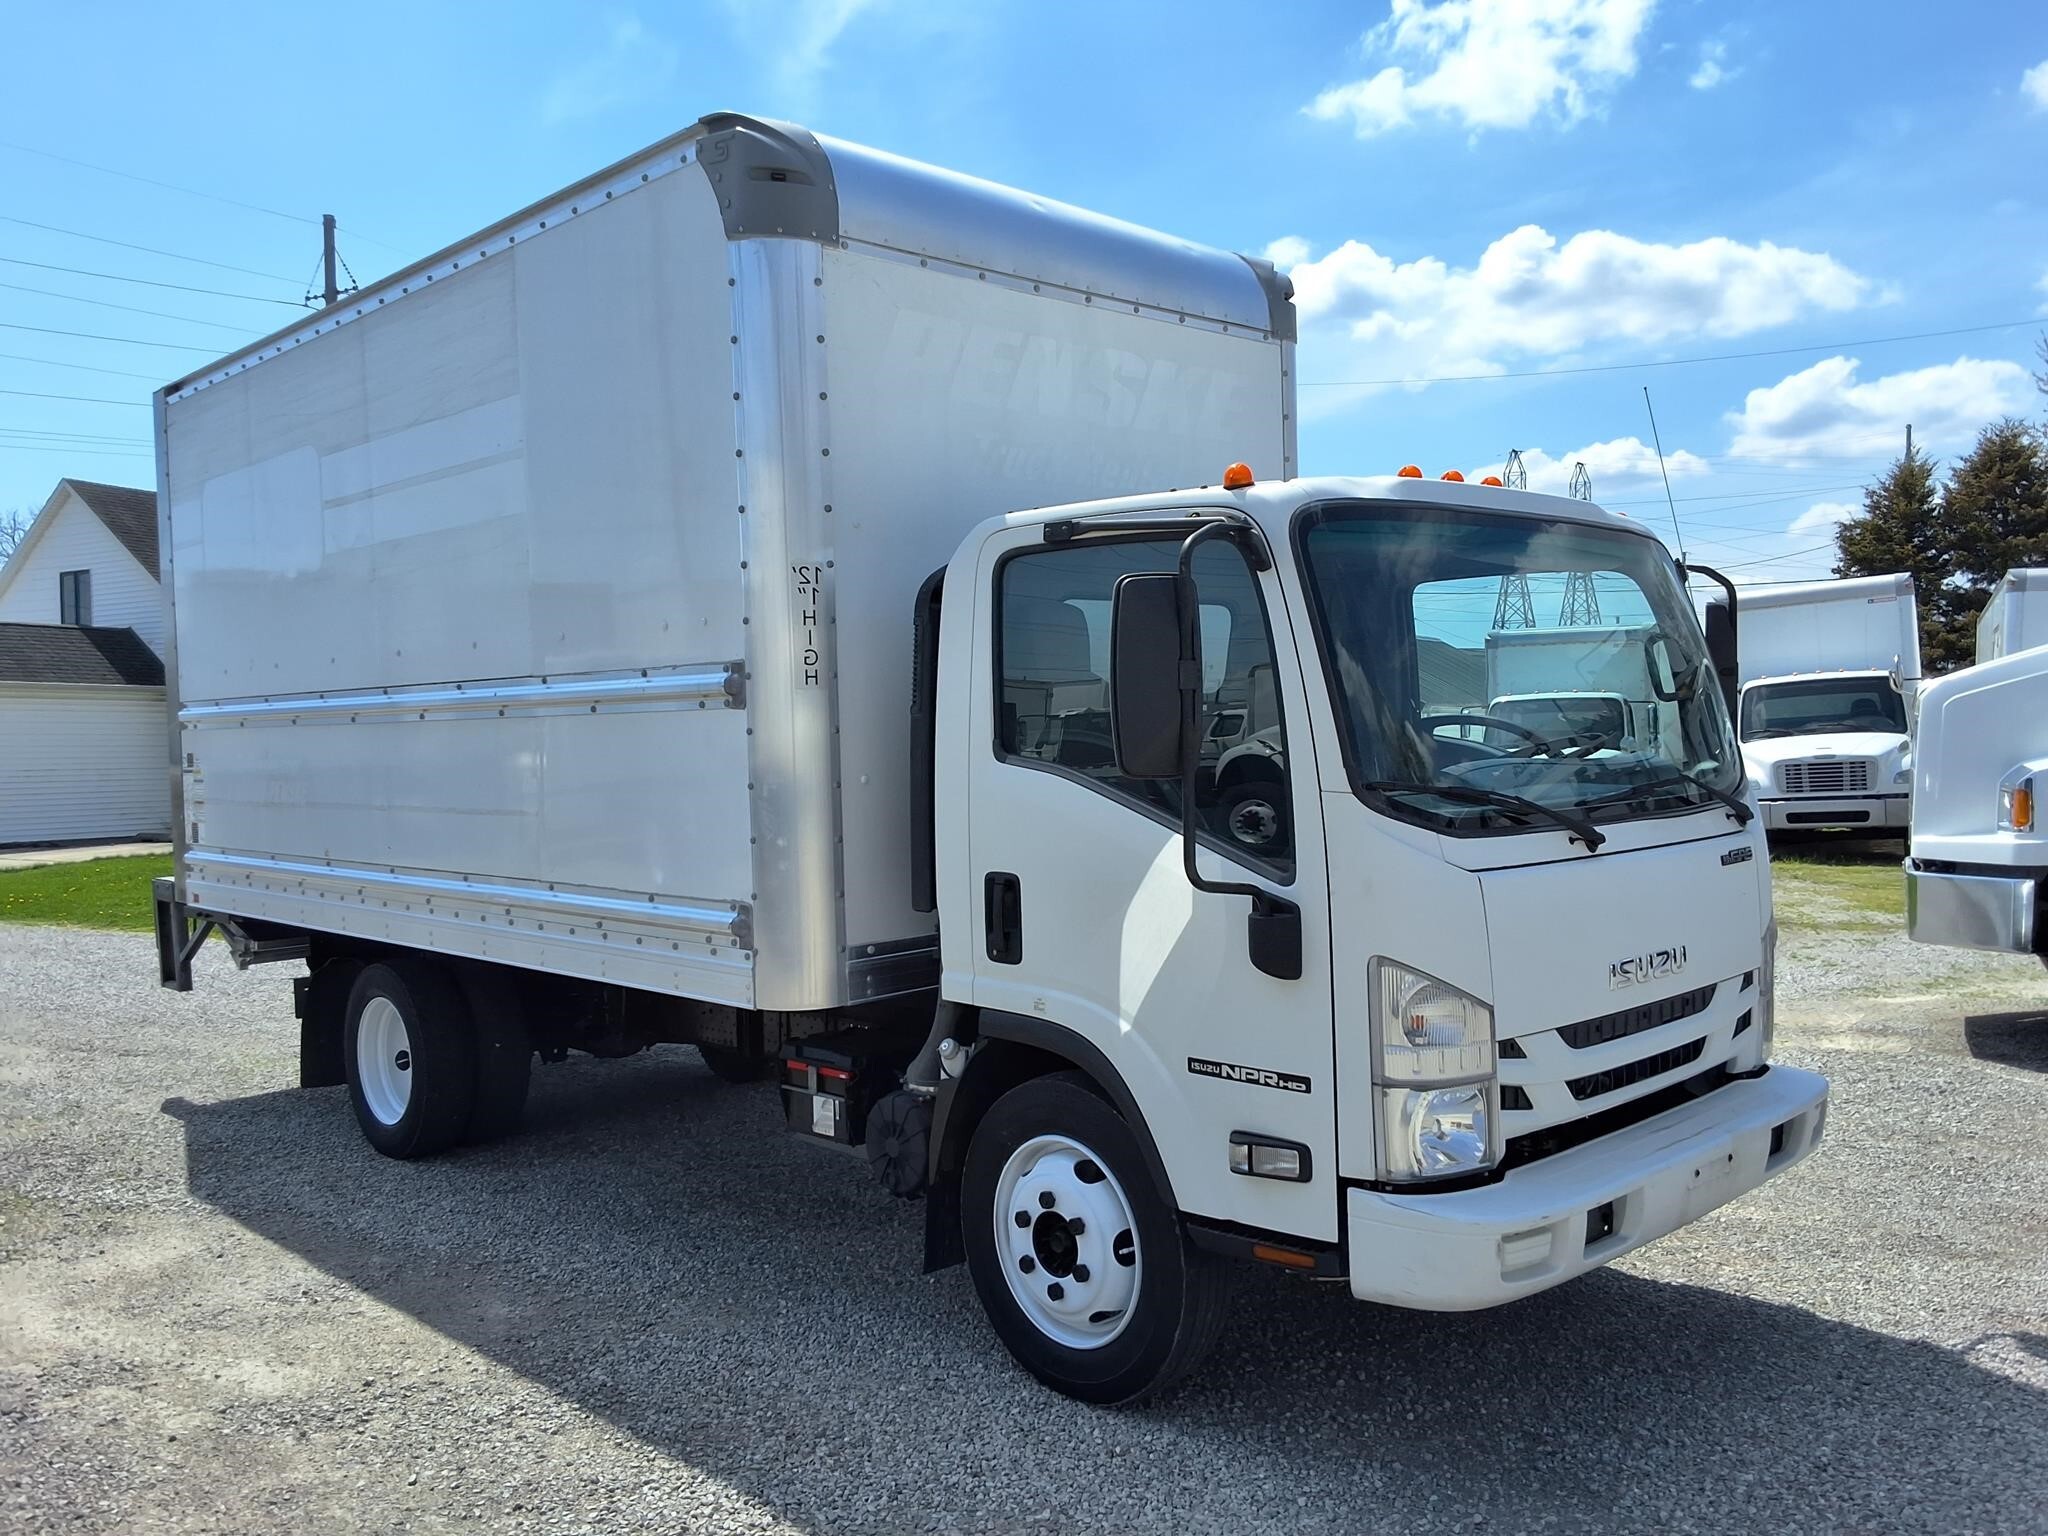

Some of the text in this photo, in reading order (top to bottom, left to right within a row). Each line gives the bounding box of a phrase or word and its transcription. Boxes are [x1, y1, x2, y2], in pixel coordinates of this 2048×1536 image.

[1609, 944, 1688, 991] ISUZU
[1191, 1061, 1306, 1091] ISUZU NPR HD
